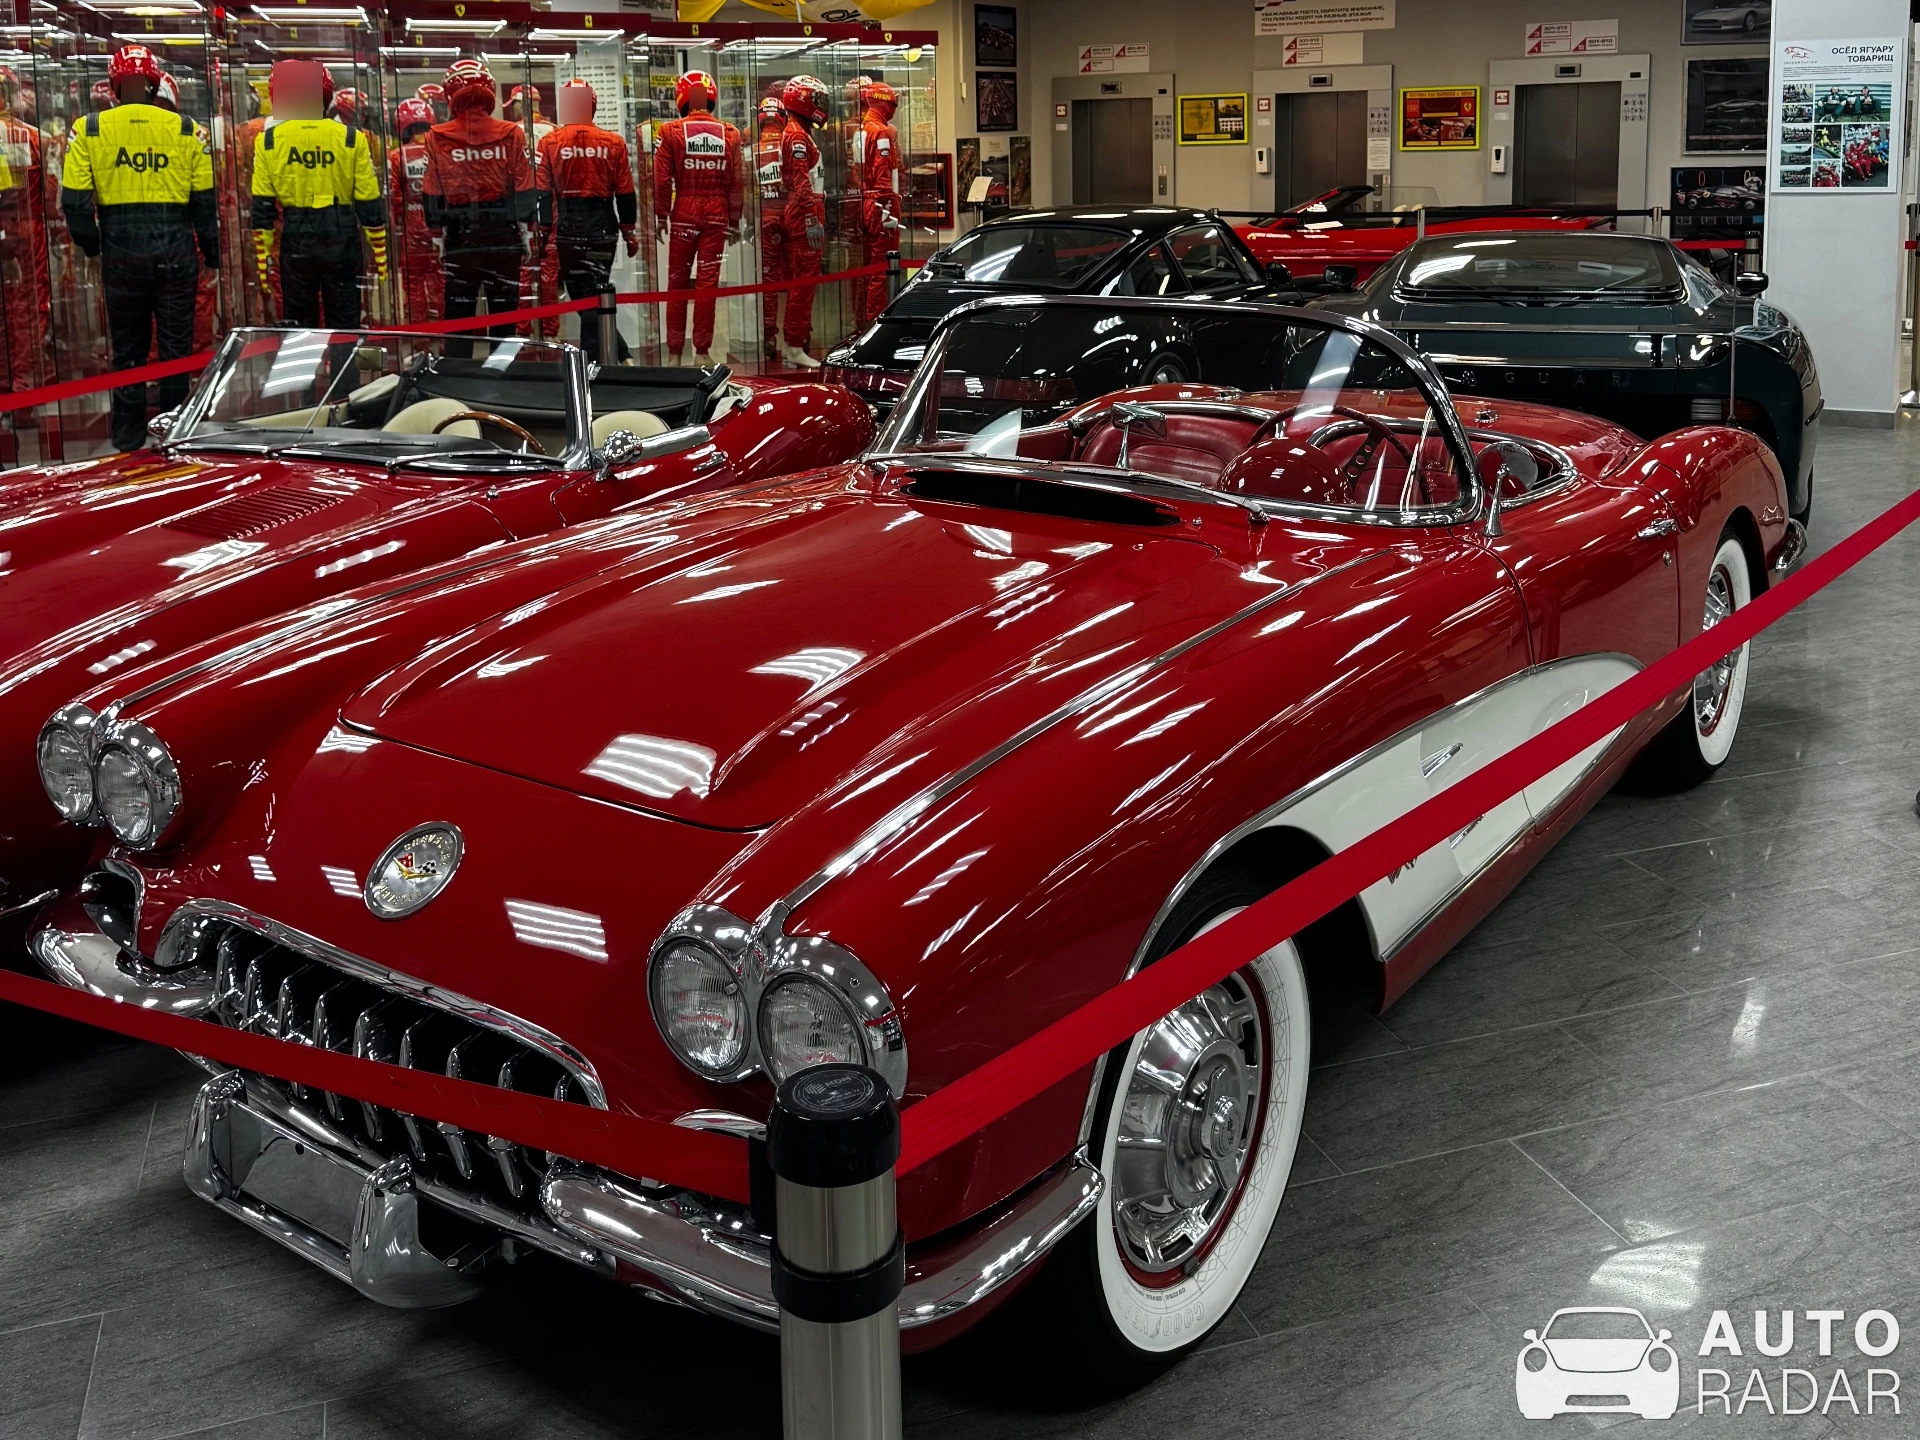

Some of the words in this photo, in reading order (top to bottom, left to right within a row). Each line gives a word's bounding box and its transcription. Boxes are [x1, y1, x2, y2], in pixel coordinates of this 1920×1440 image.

[1831, 46, 1857, 54] ОСЁЛ
[1859, 45, 1894, 54] ЯГУАРУ
[1847, 54, 1894, 63] ТОВАРИЩ
[560, 146, 609, 160] Shell
[687, 137, 724, 154] Marlboro
[115, 147, 169, 173] Agip
[287, 145, 335, 170] Agip
[451, 146, 506, 162] Shell
[683, 158, 727, 171] Shell
[763, 191, 779, 199] 2001
[1463, 370, 1622, 387] AGUAR
